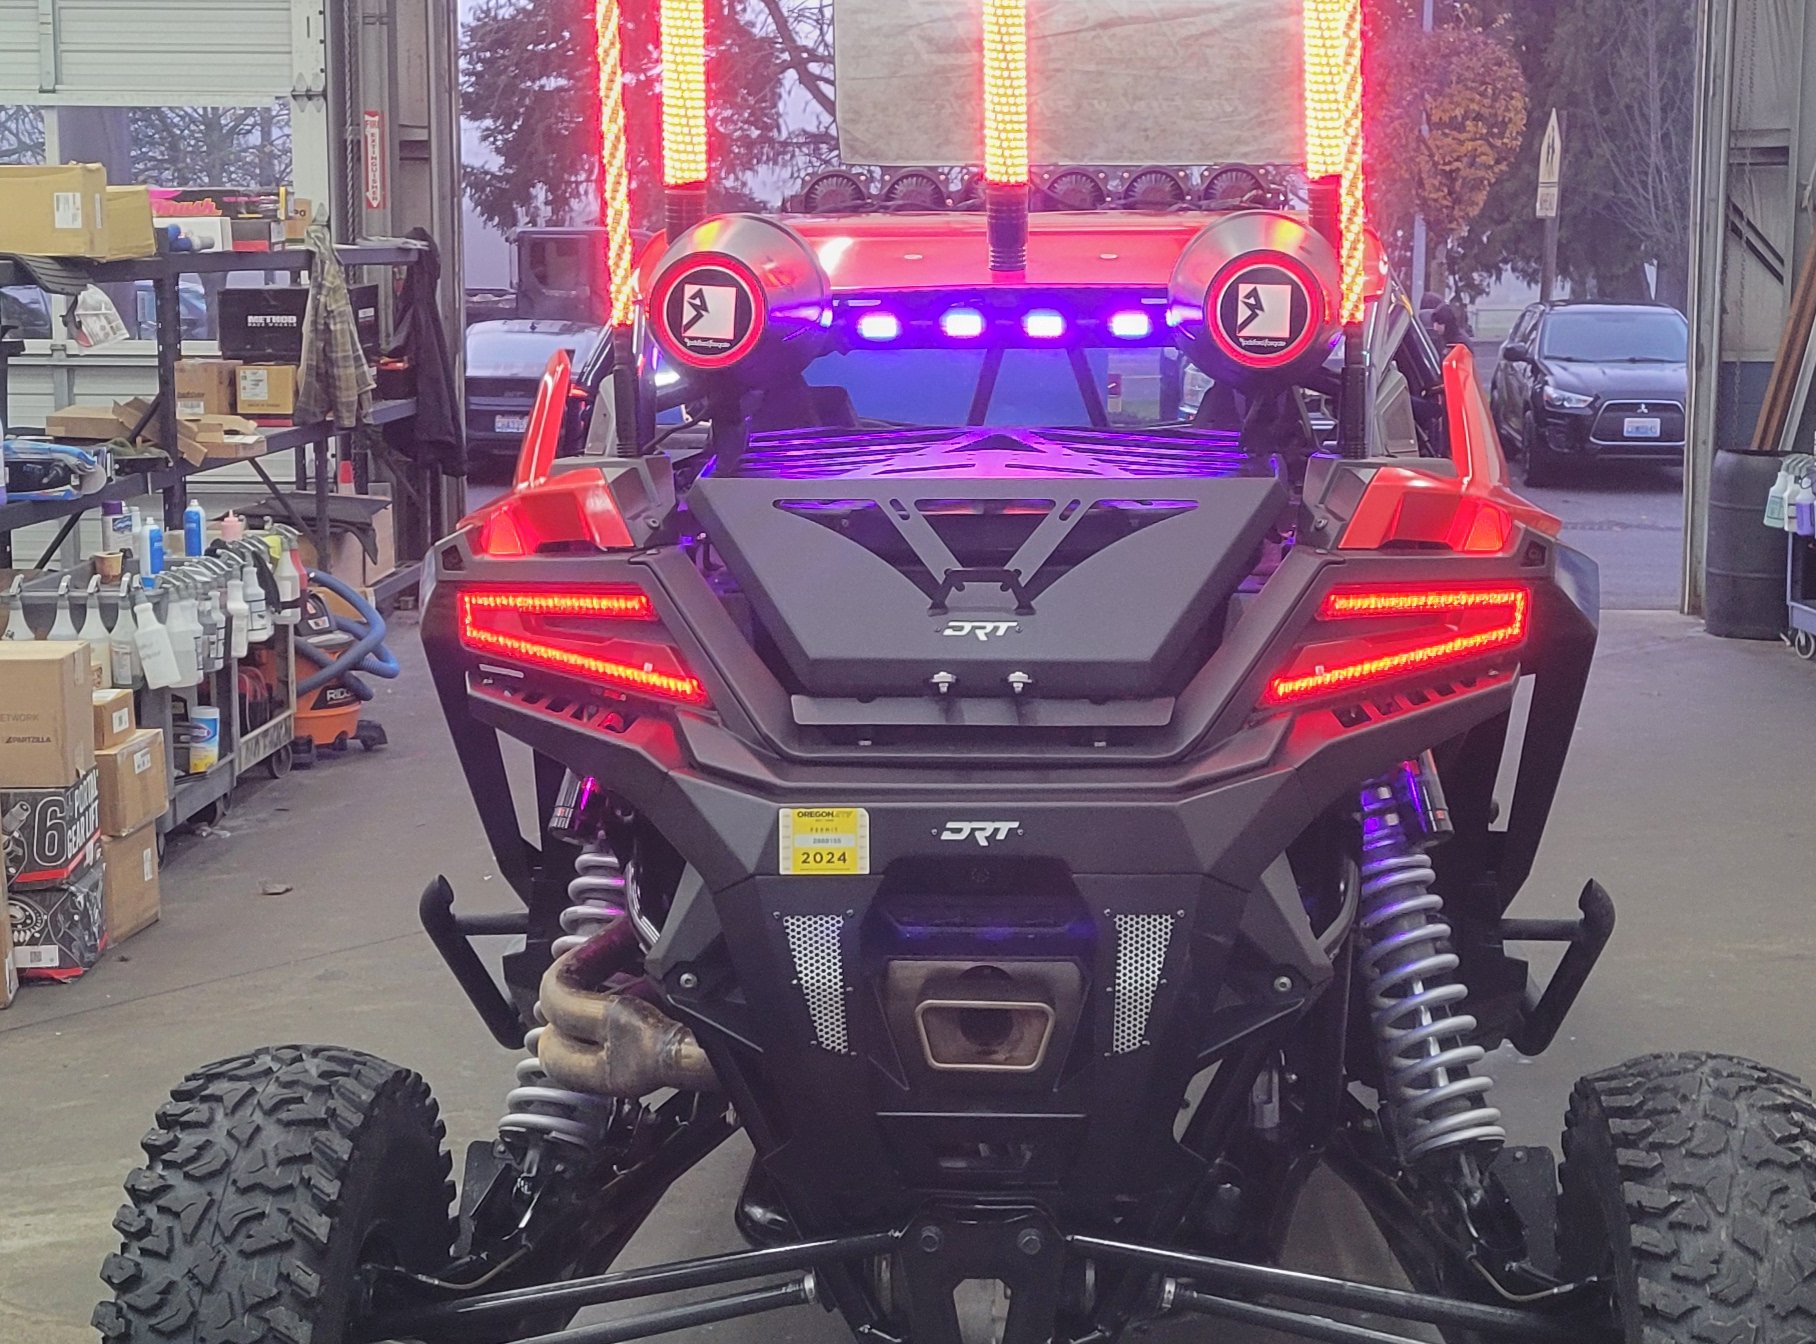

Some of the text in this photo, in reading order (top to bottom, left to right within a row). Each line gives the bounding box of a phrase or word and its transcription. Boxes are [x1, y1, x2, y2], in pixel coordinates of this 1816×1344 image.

[370, 132, 379, 202] EXTINGUISHER
[943, 621, 1018, 641] DRT
[796, 810, 834, 819] OREGON
[67, 815, 86, 860] GEAR
[85, 798, 99, 839] LIFT
[940, 820, 1020, 847] DRT
[800, 851, 847, 864] 2024
